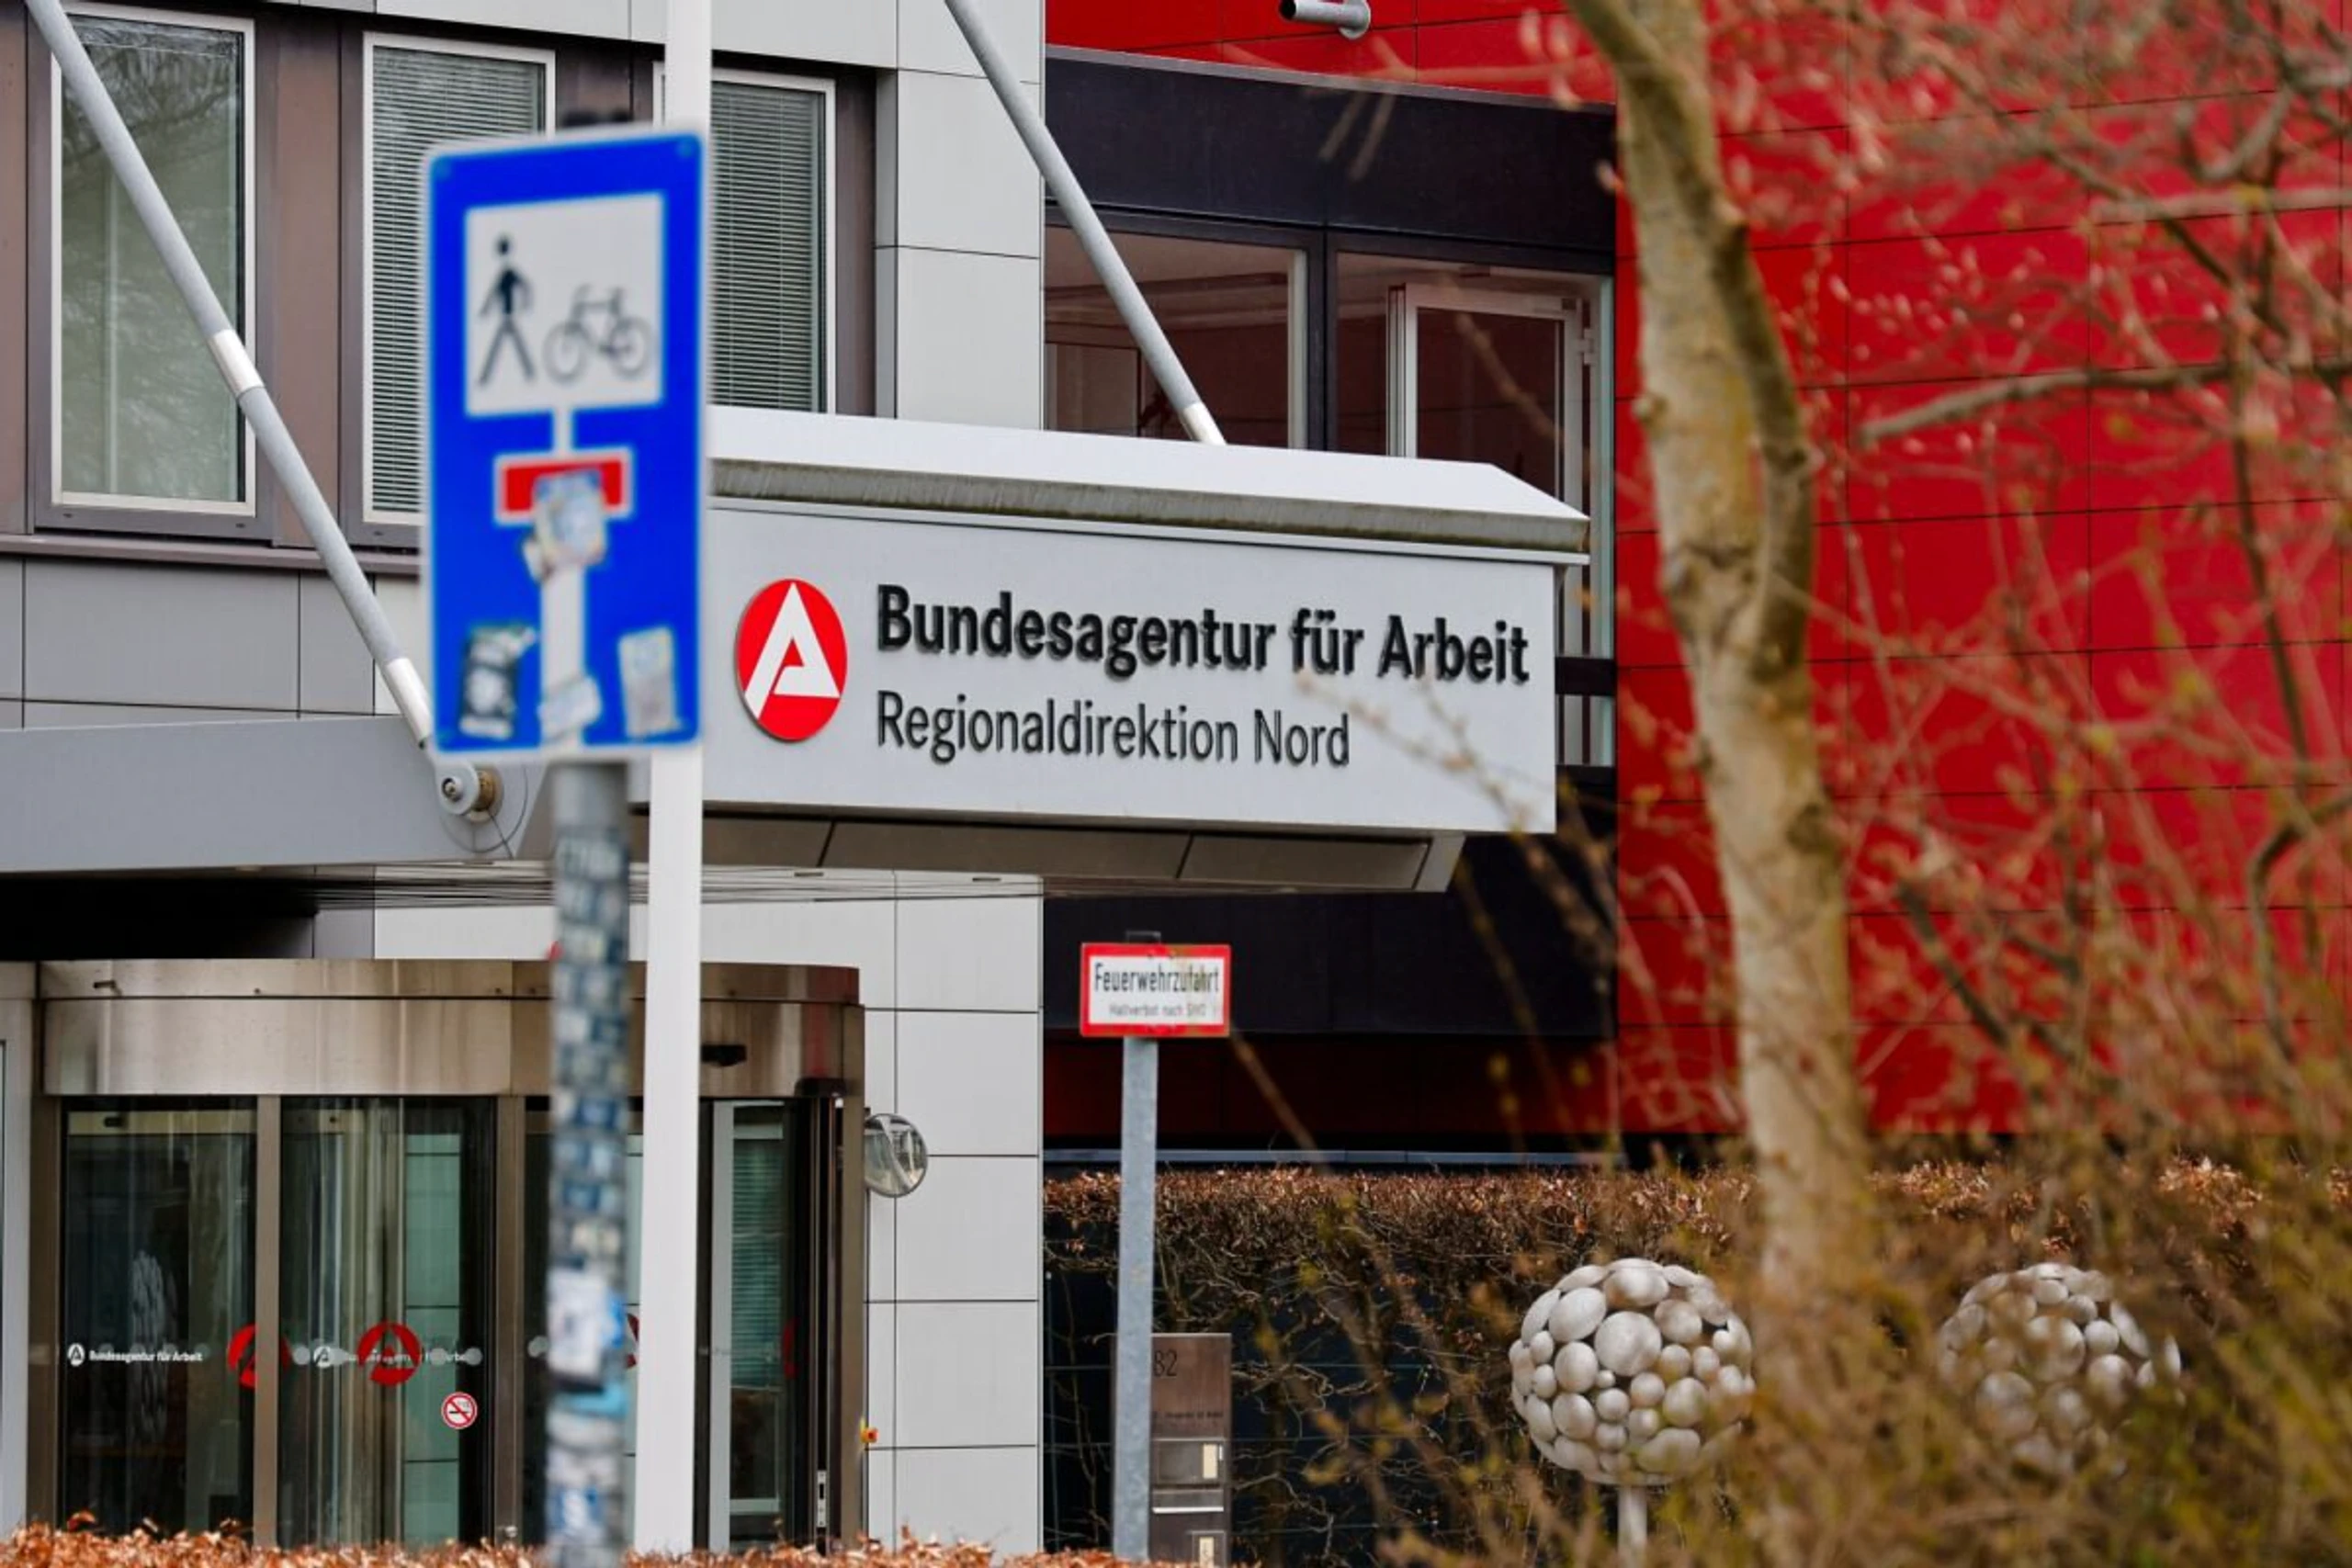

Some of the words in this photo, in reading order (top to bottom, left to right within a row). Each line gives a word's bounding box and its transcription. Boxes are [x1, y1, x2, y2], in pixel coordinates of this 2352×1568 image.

[876, 584, 1276, 679] Bundesagentur
[1289, 607, 1364, 675] für
[1376, 614, 1530, 685] Arbeit
[876, 690, 1238, 764] Regionaldirektion
[1253, 708, 1350, 768] Nord
[1094, 962, 1219, 992] Feuerwehrzufahrt
